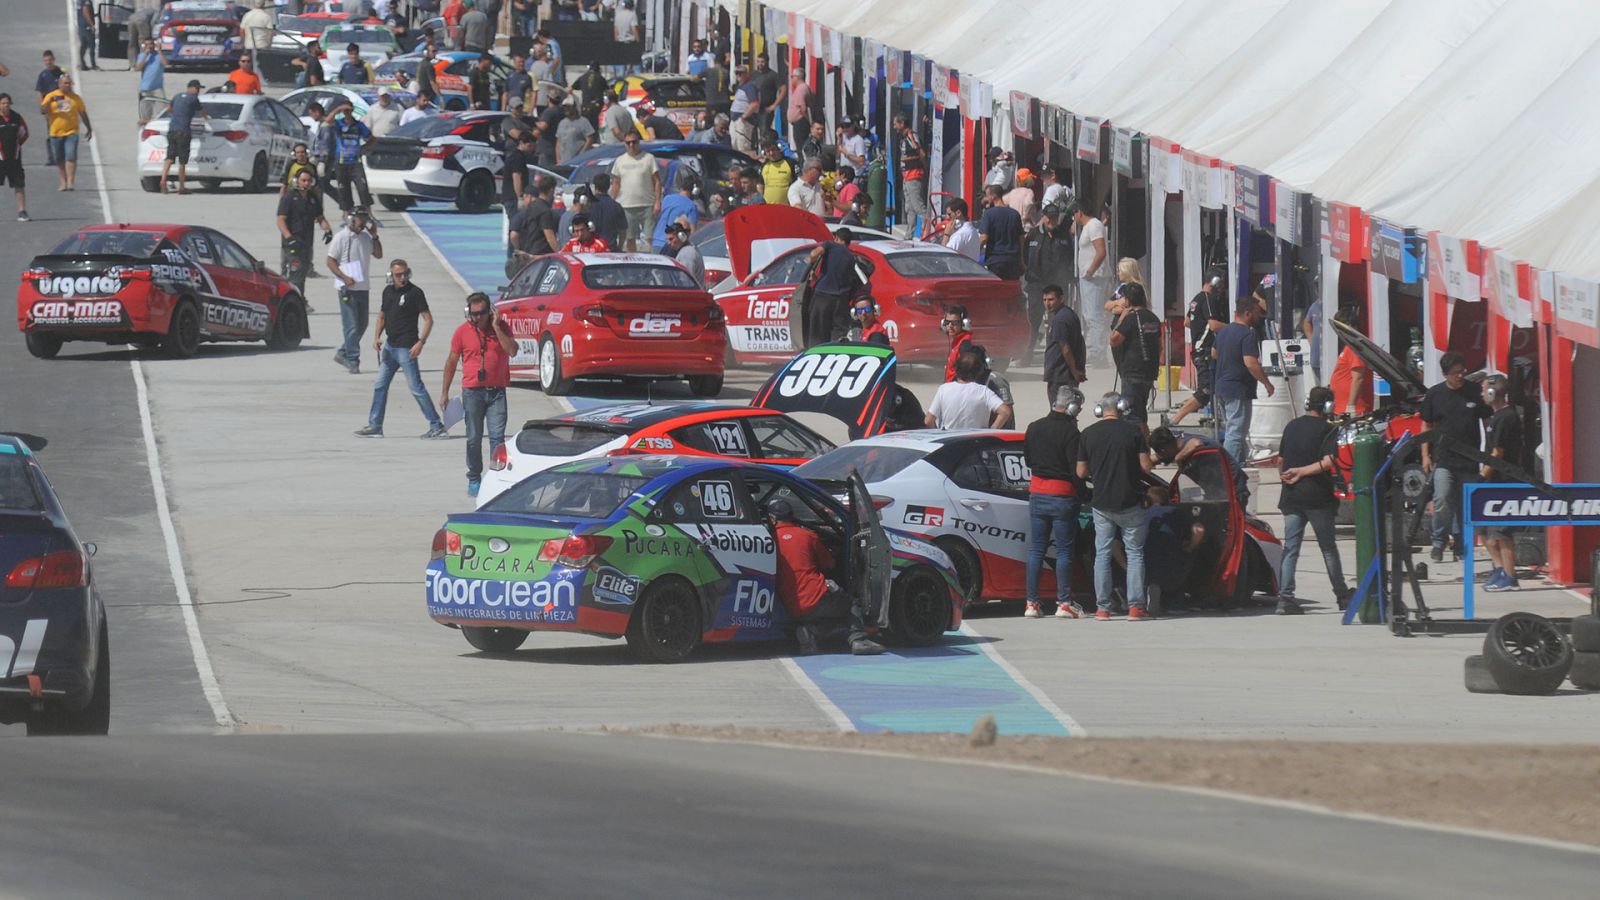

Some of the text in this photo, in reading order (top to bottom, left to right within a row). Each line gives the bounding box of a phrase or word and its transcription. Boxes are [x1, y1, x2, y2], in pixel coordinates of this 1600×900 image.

[196, 239, 208, 254] 5
[33, 301, 121, 318] CAN-MAR
[202, 302, 268, 332] TECNOPHOS
[629, 312, 681, 333] der
[745, 327, 789, 341] TRANS
[711, 426, 745, 450] 121
[1004, 455, 1032, 481] 68
[704, 484, 731, 511] 46
[903, 511, 944, 527] GR
[950, 517, 1026, 542] TOYOTA
[621, 530, 696, 558] PUCARA
[459, 544, 536, 574] PUCARA
[599, 574, 635, 596] Elite
[454, 607, 507, 620] INTEGRALES
[509, 610, 523, 620] DE
